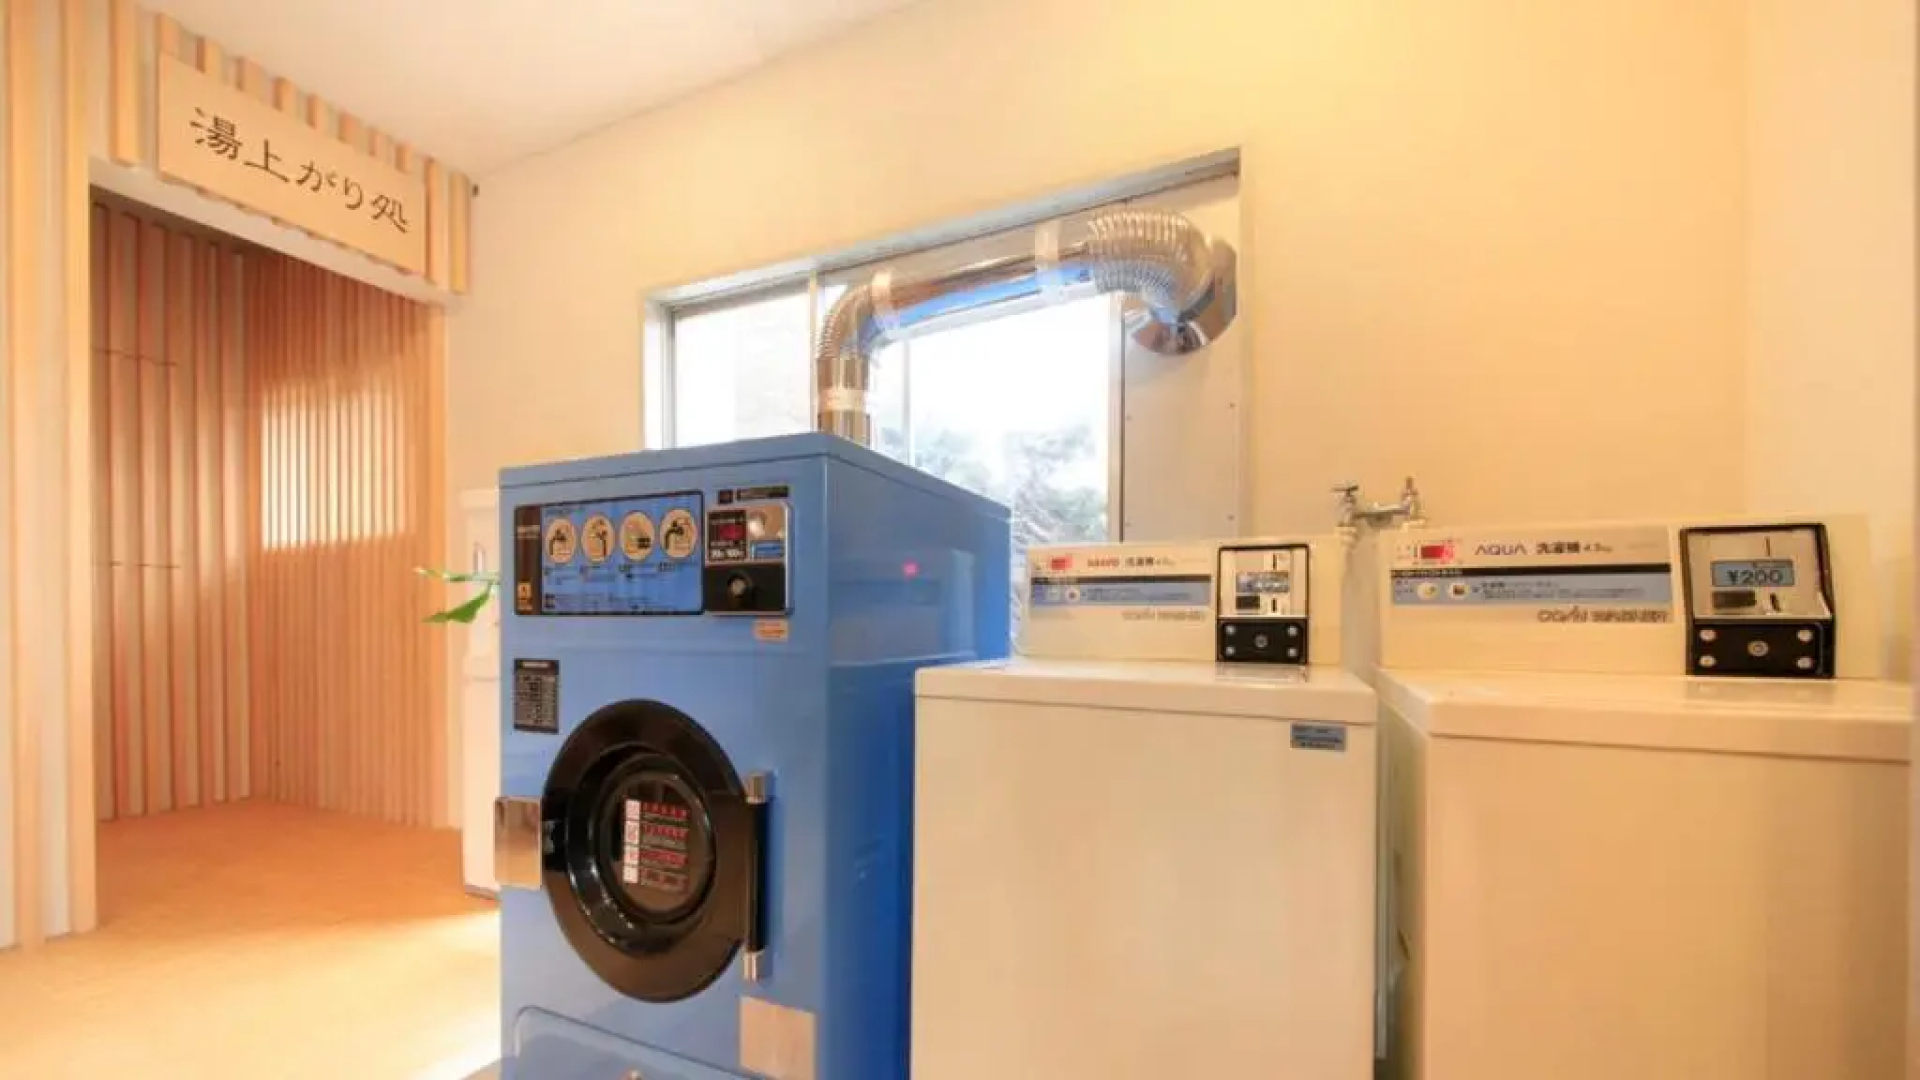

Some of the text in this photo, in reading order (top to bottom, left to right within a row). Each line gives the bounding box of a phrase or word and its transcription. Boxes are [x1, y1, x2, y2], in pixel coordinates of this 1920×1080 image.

[190, 106, 408, 234] 湯上がり処
[1475, 543, 1527, 555] AQUA
[1727, 569, 1783, 585] ¥200
